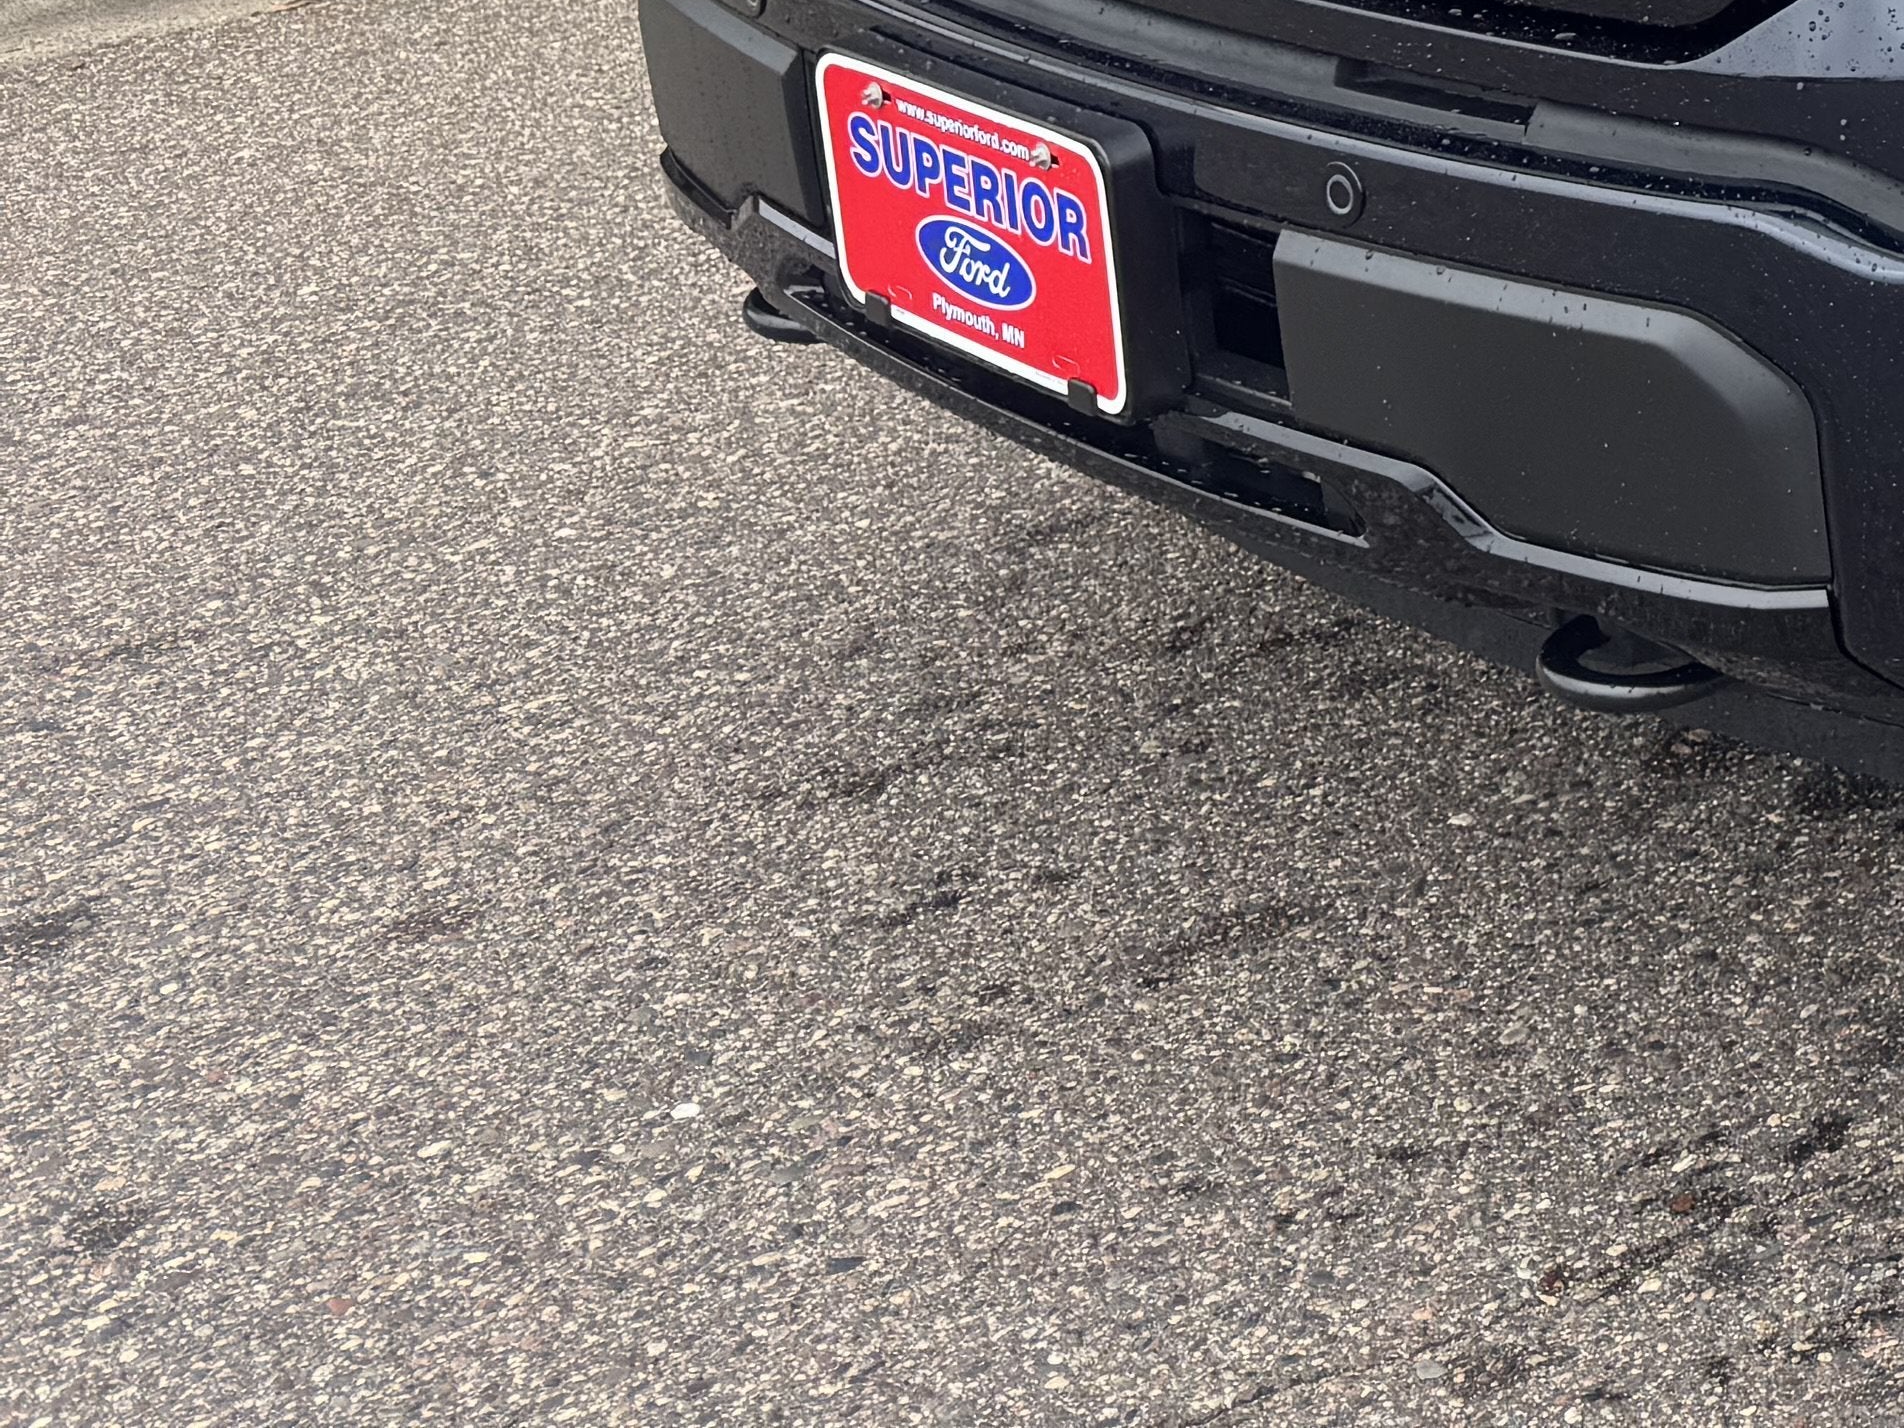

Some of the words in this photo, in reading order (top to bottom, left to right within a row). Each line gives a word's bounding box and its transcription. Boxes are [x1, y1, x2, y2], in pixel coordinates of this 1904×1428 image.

[895, 98, 1030, 161] www.superiorford.com
[847, 111, 1092, 265] SUPERIOR
[939, 225, 1011, 298] Ford
[932, 292, 1000, 340] Plymouth,
[1001, 322, 1025, 349] MN
